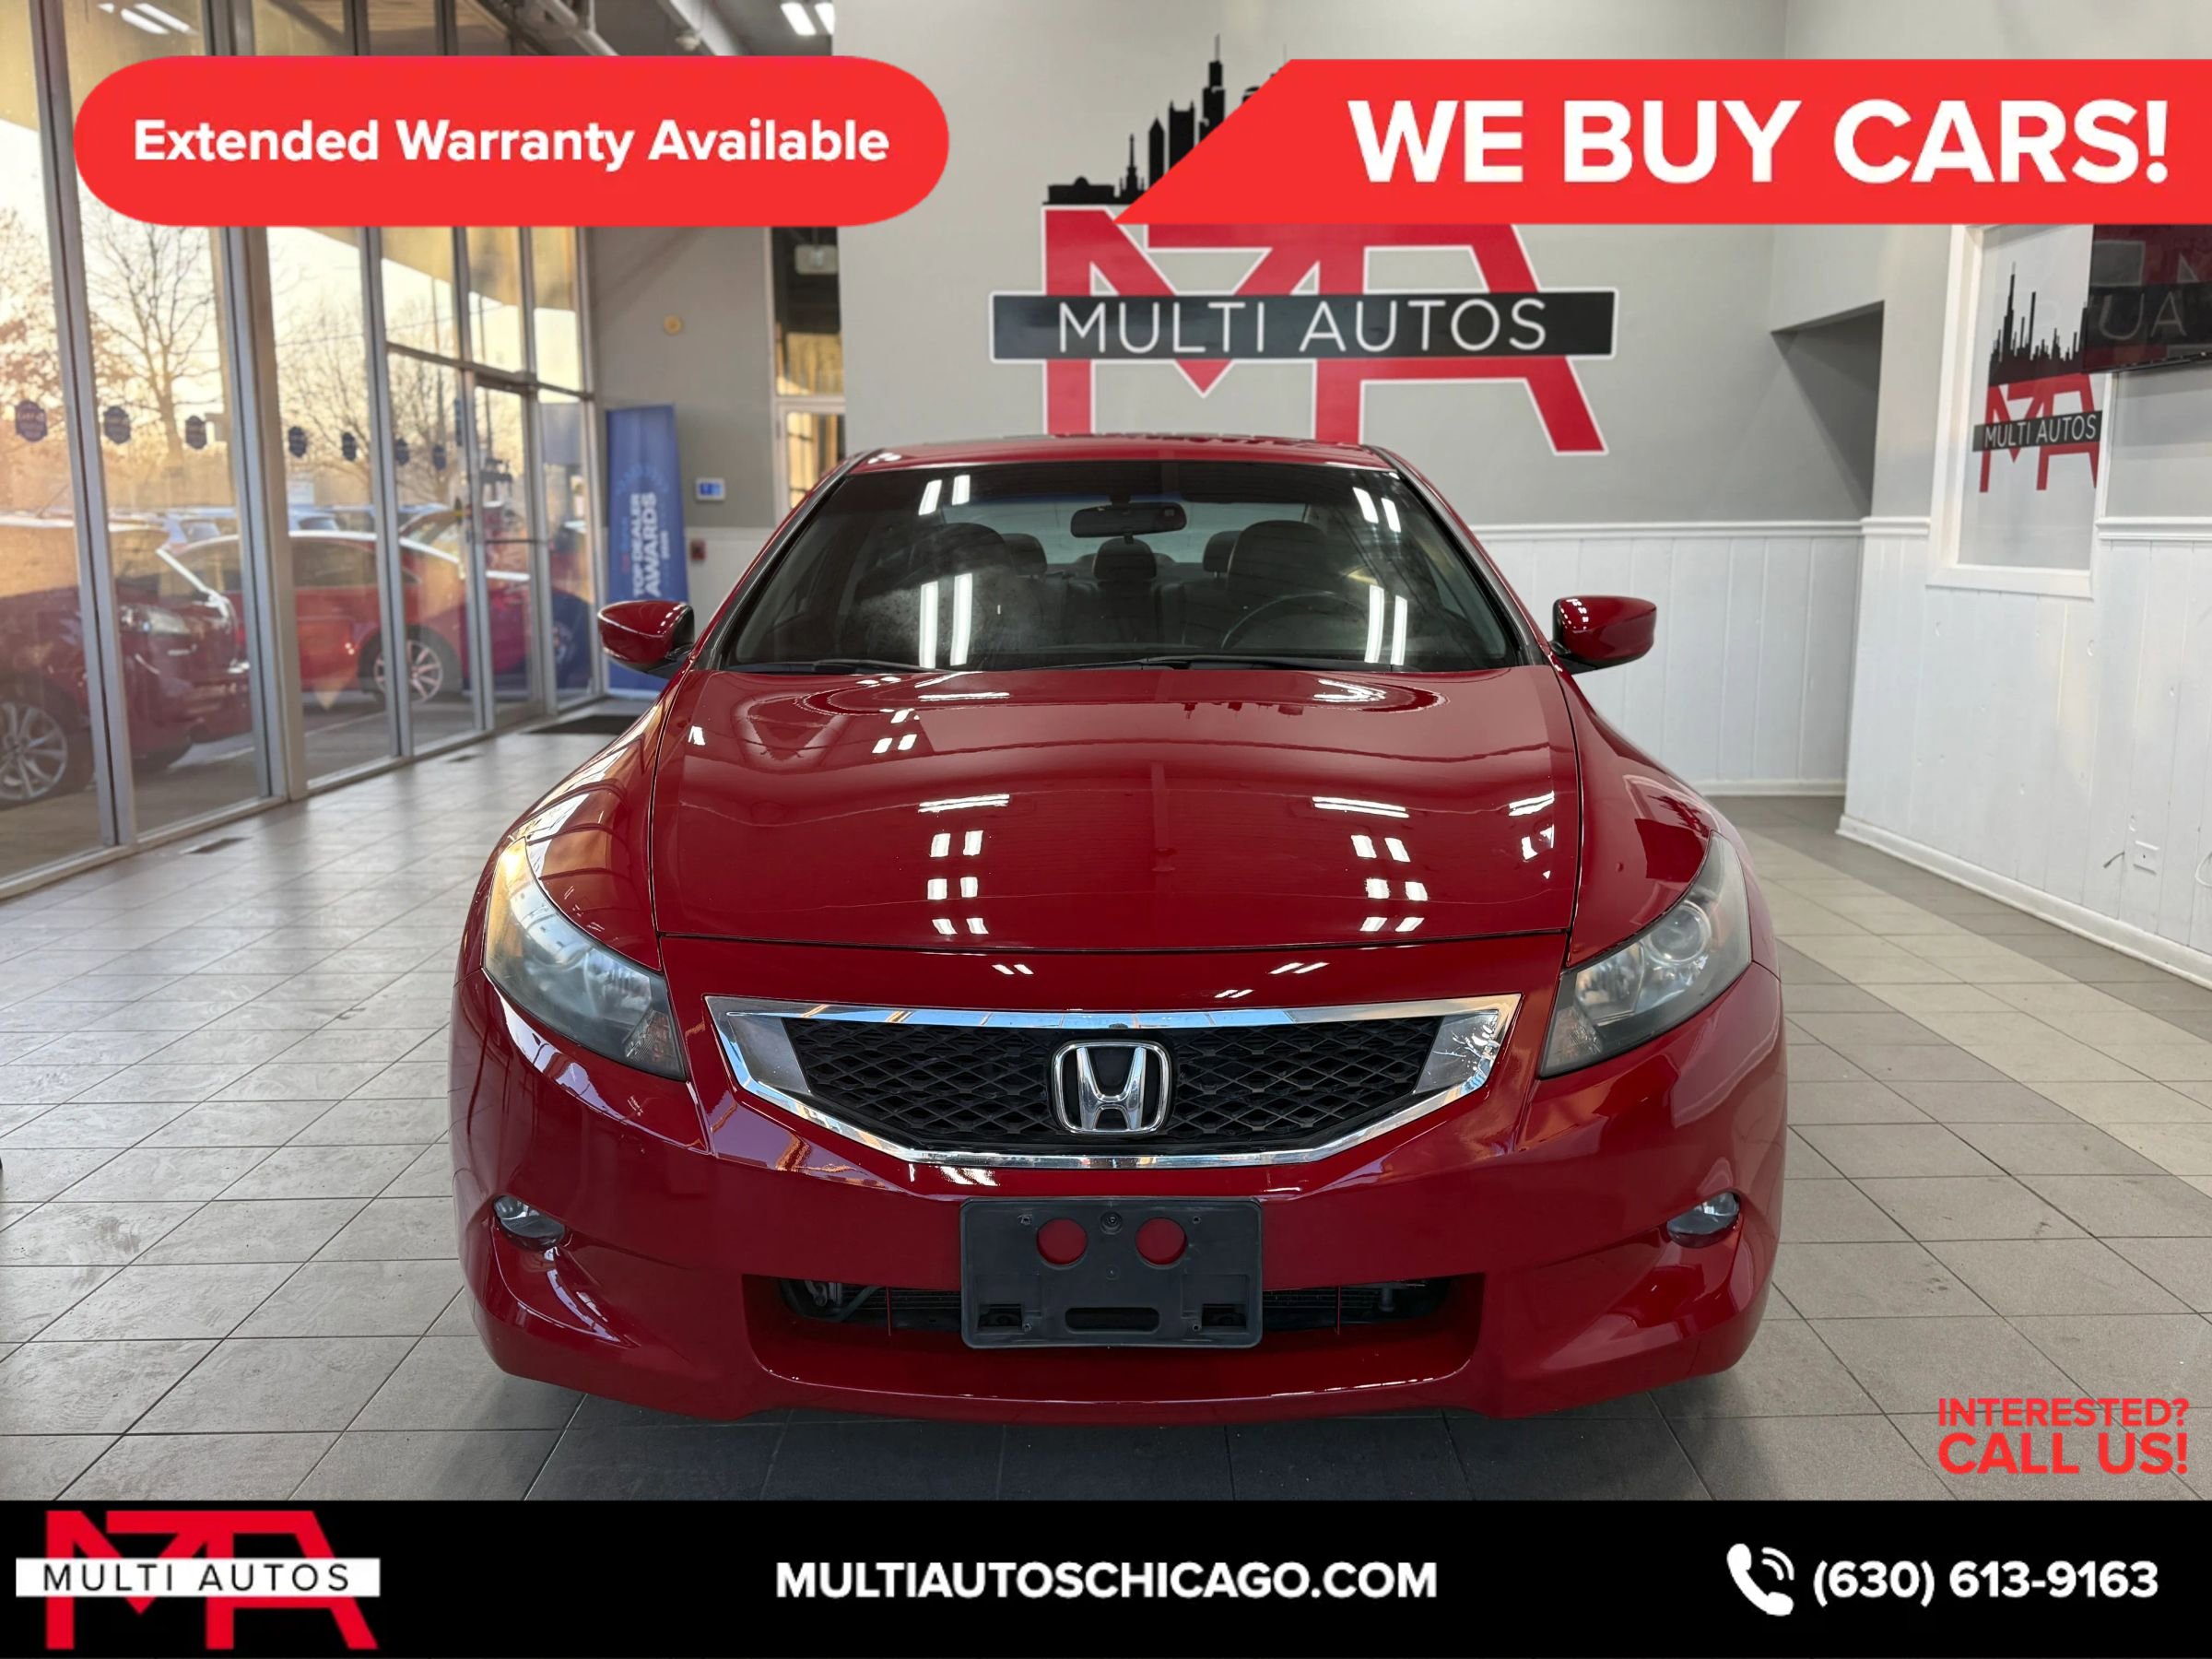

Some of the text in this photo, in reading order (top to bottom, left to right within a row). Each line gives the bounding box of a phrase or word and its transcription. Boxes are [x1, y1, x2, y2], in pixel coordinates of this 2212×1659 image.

[1059, 298, 1547, 353] MULTI AUTOS
[1983, 414, 2097, 449] MULTI AUTOS
[629, 492, 645, 597] TOP DEALER
[641, 491, 662, 597] AWARDS
